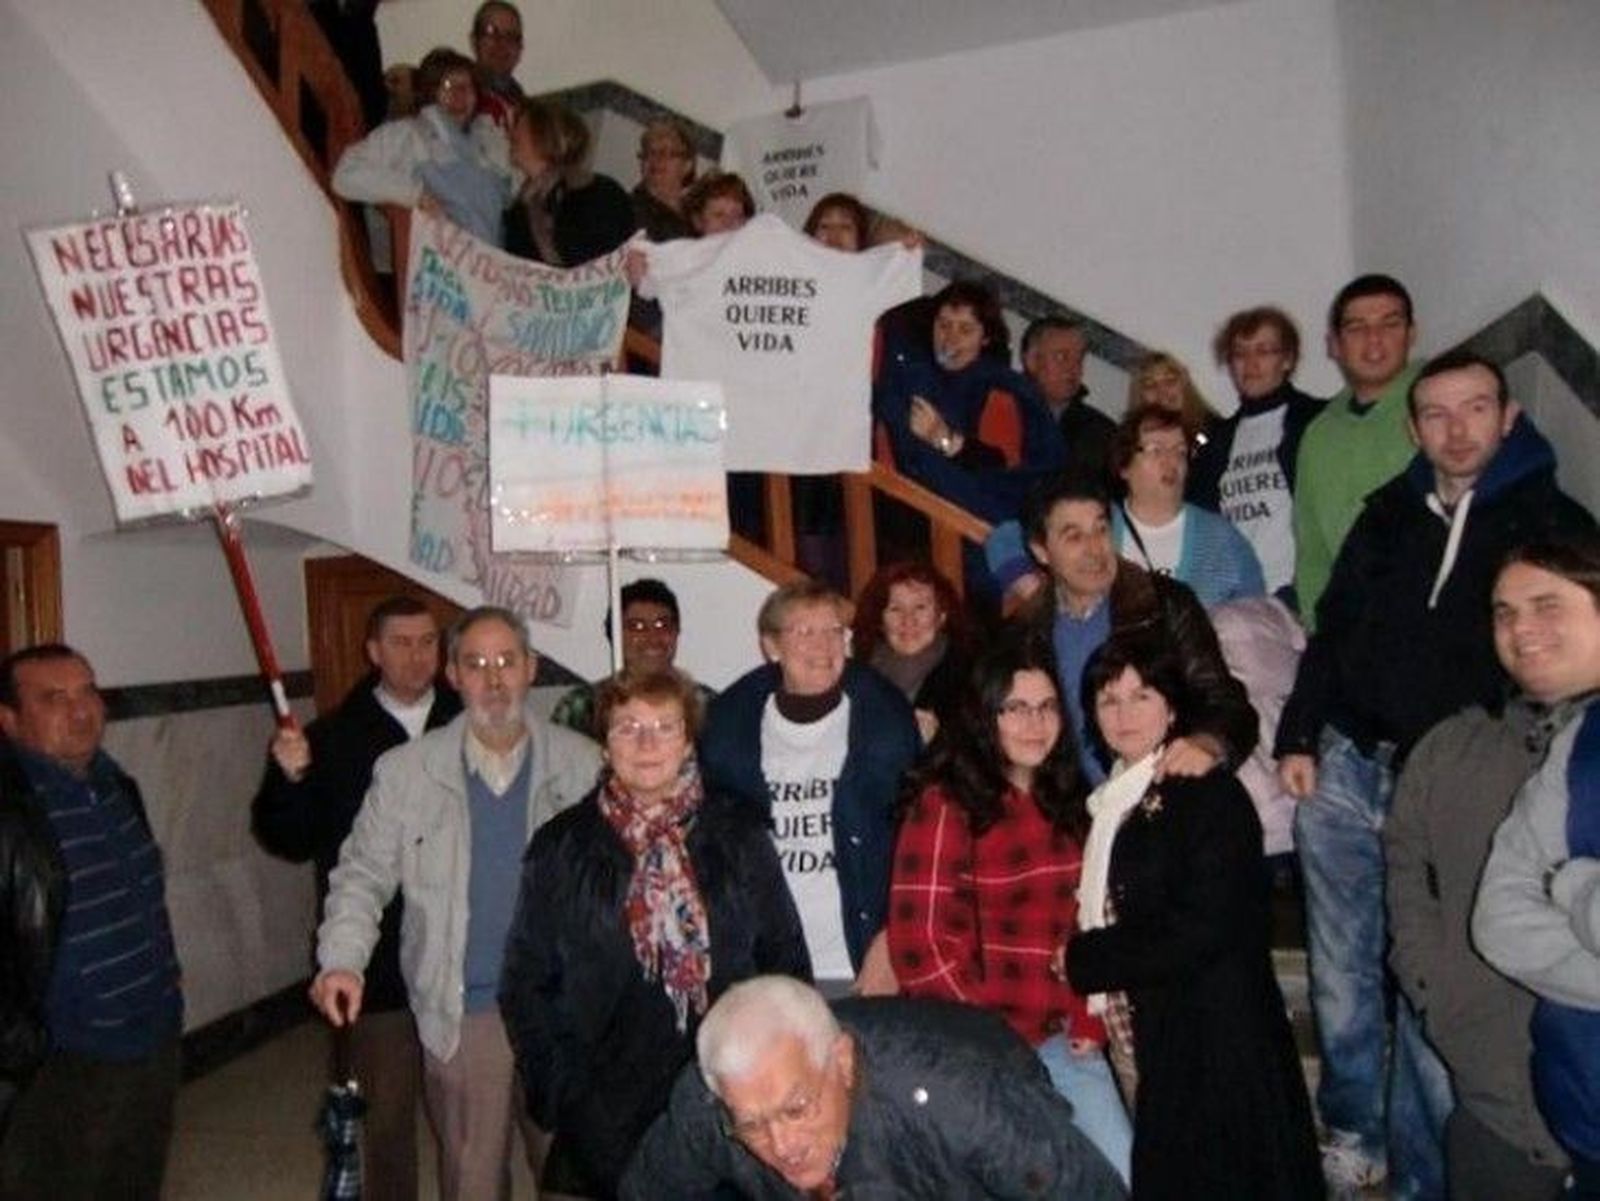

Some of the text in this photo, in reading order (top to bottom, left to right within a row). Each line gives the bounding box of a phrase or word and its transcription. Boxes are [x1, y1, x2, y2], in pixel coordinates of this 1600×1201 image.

[769, 184, 808, 202] VIDA
[71, 262, 258, 320] NUESTRAS
[723, 276, 817, 298] ARRIBES
[726, 304, 809, 326] QUIERE
[737, 331, 794, 352] VIDA
[101, 351, 268, 414] ESTAMOS
[122, 424, 143, 453] A
[165, 402, 227, 441] 100
[1221, 473, 1287, 498] UIERE
